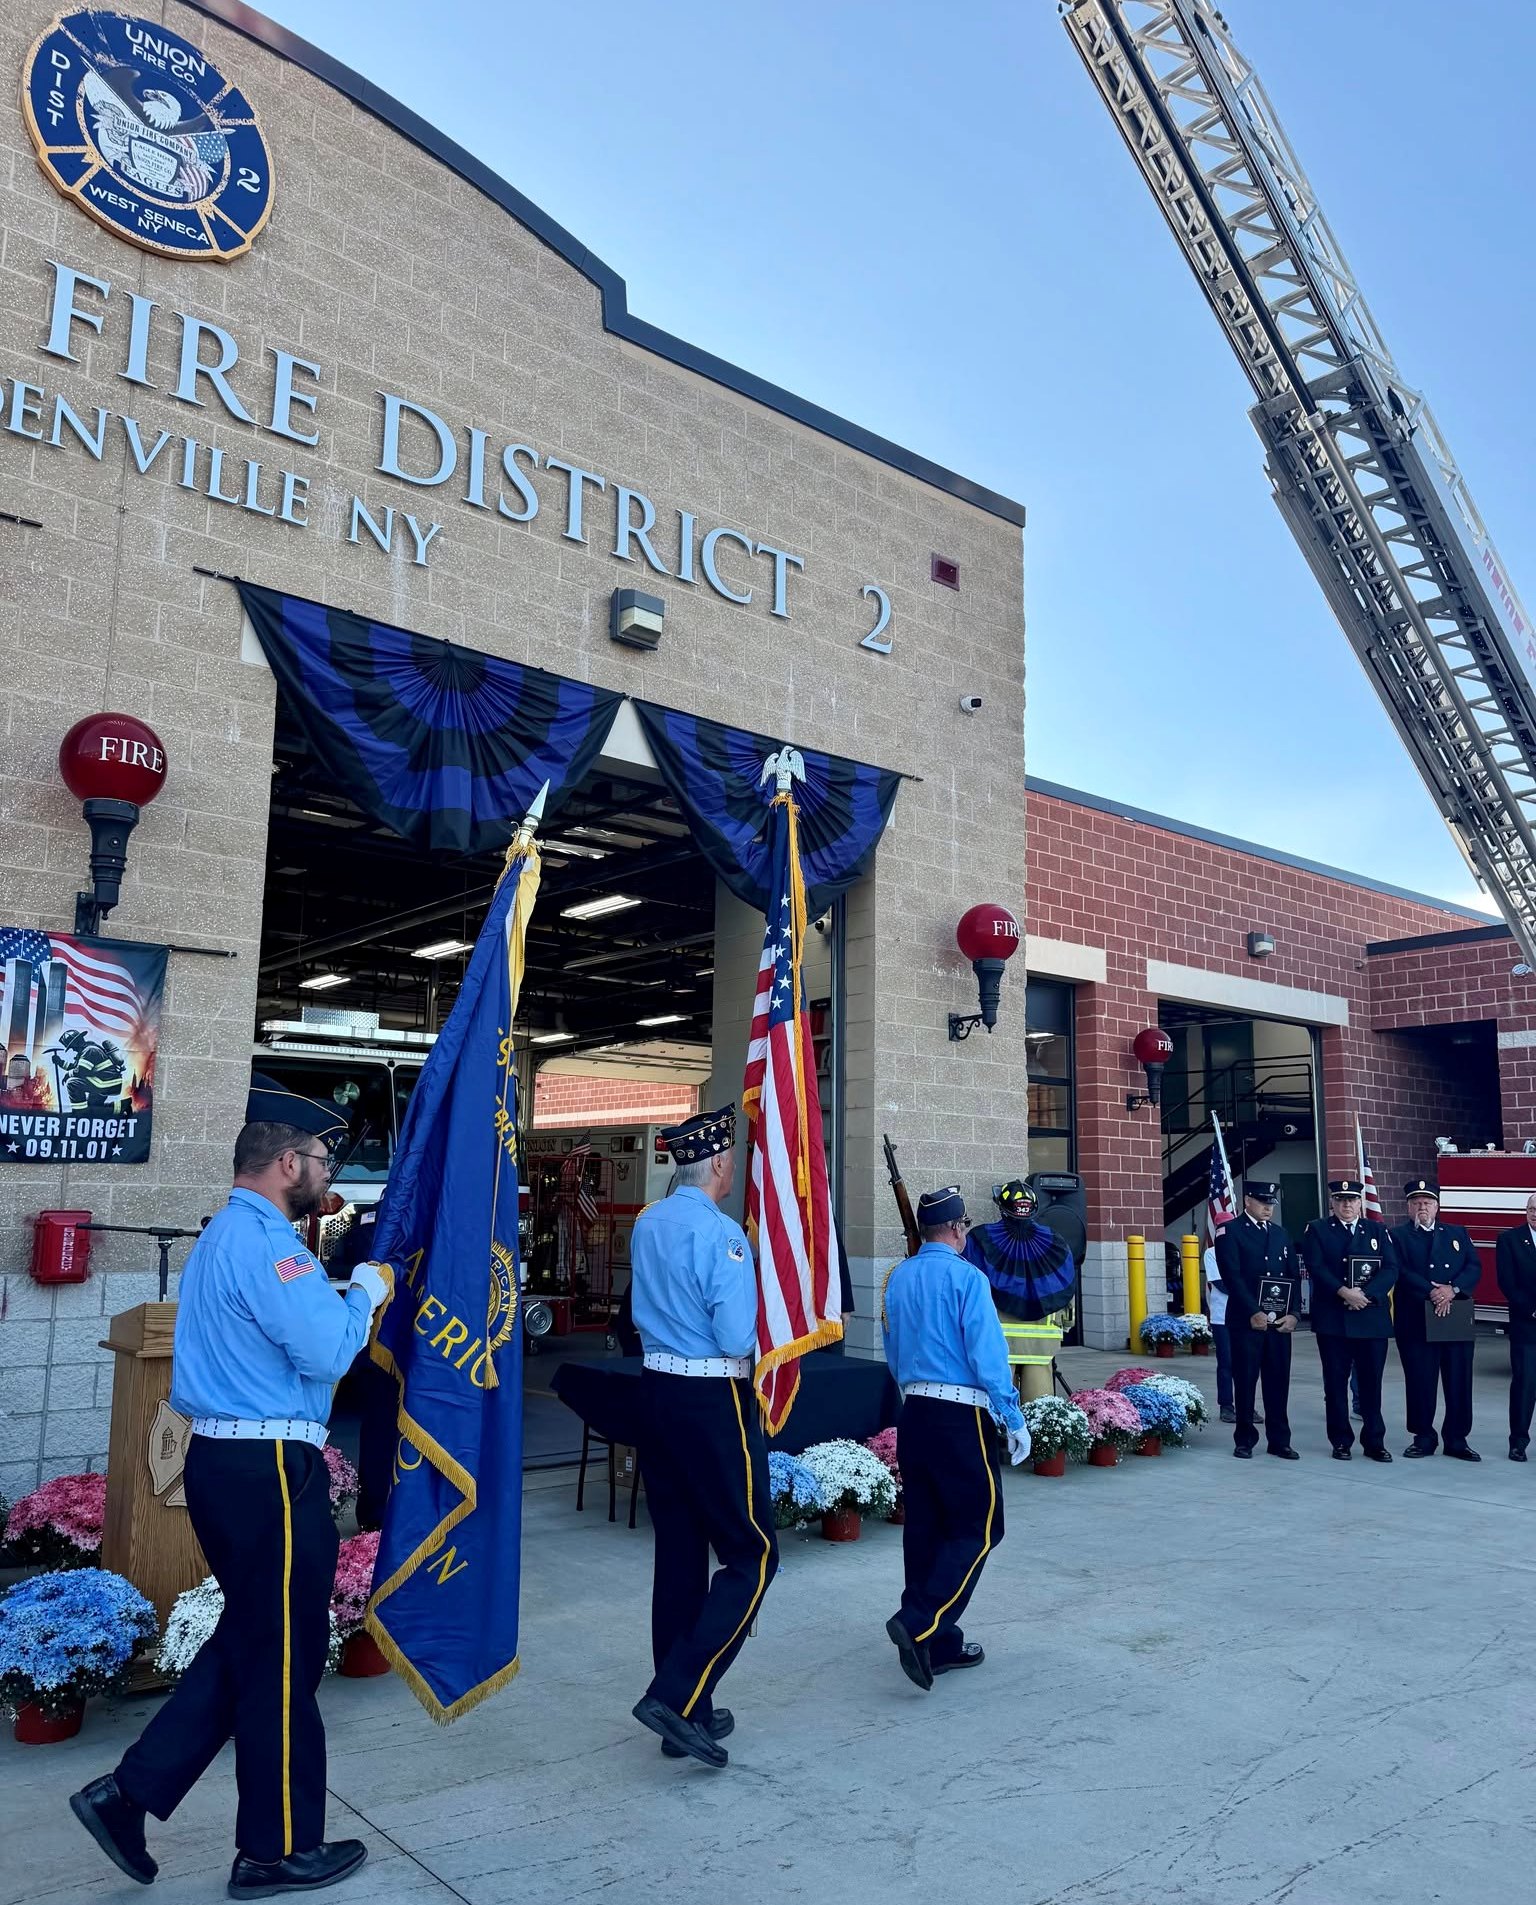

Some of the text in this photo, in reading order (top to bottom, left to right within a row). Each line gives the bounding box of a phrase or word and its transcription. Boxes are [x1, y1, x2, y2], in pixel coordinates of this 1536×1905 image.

[125, 23, 207, 77] UNION
[132, 44, 167, 71] FIRE
[46, 49, 71, 127] DIST
[116, 117, 193, 158] UNION FIRE COMPANY
[124, 163, 182, 195] EAGLES
[236, 167, 261, 194] 2
[88, 184, 209, 245] WEST SENECA
[137, 215, 163, 235] NY
[0, 376, 444, 568] ENVILLE NY
[38, 258, 893, 654] FIRE DISTRICT 2
[99, 736, 164, 774] FIRE
[992, 920, 1020, 938] FIR
[65, 1116, 138, 1139] FORGET
[25, 1138, 107, 1159] 09.11.01
[491, 1254, 510, 1312] RICAN
